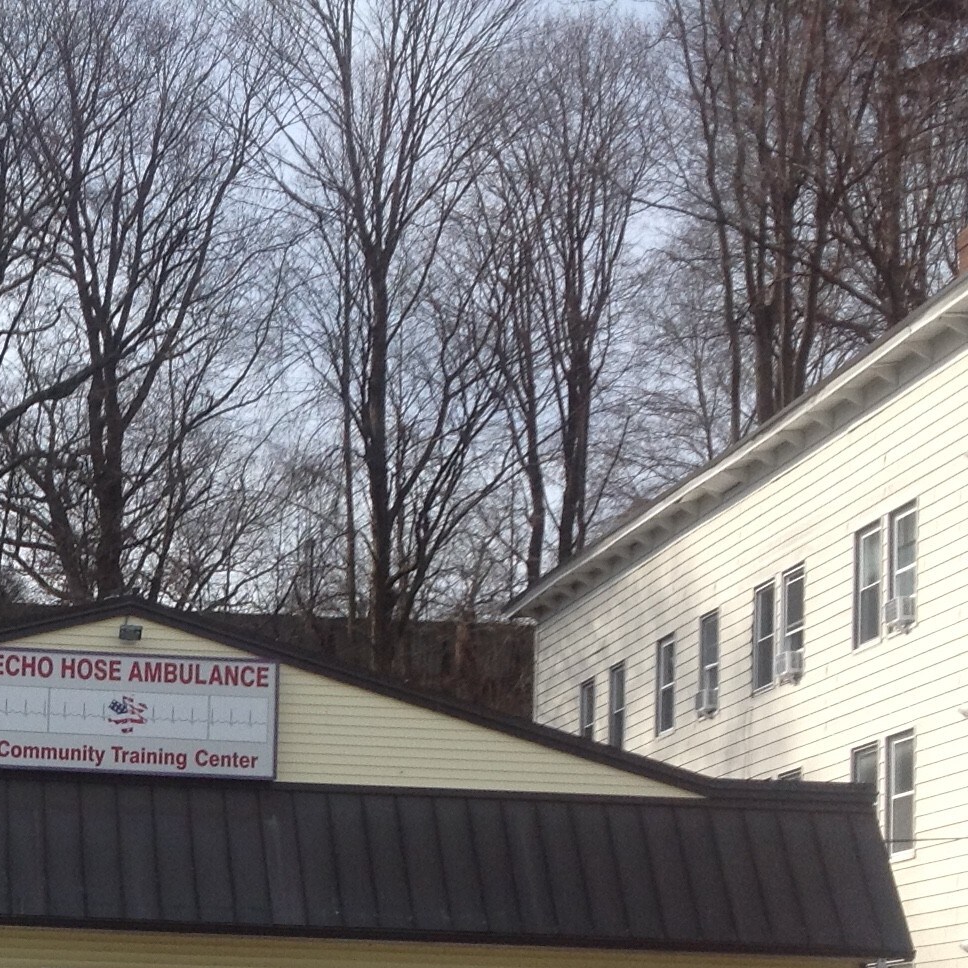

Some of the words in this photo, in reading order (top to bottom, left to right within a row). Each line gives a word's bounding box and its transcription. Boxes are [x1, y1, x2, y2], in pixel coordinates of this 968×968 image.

[61, 657, 122, 681] HOSE
[128, 661, 270, 687] AMBULANCE
[111, 746, 187, 770] Training
[195, 749, 259, 769] Center
